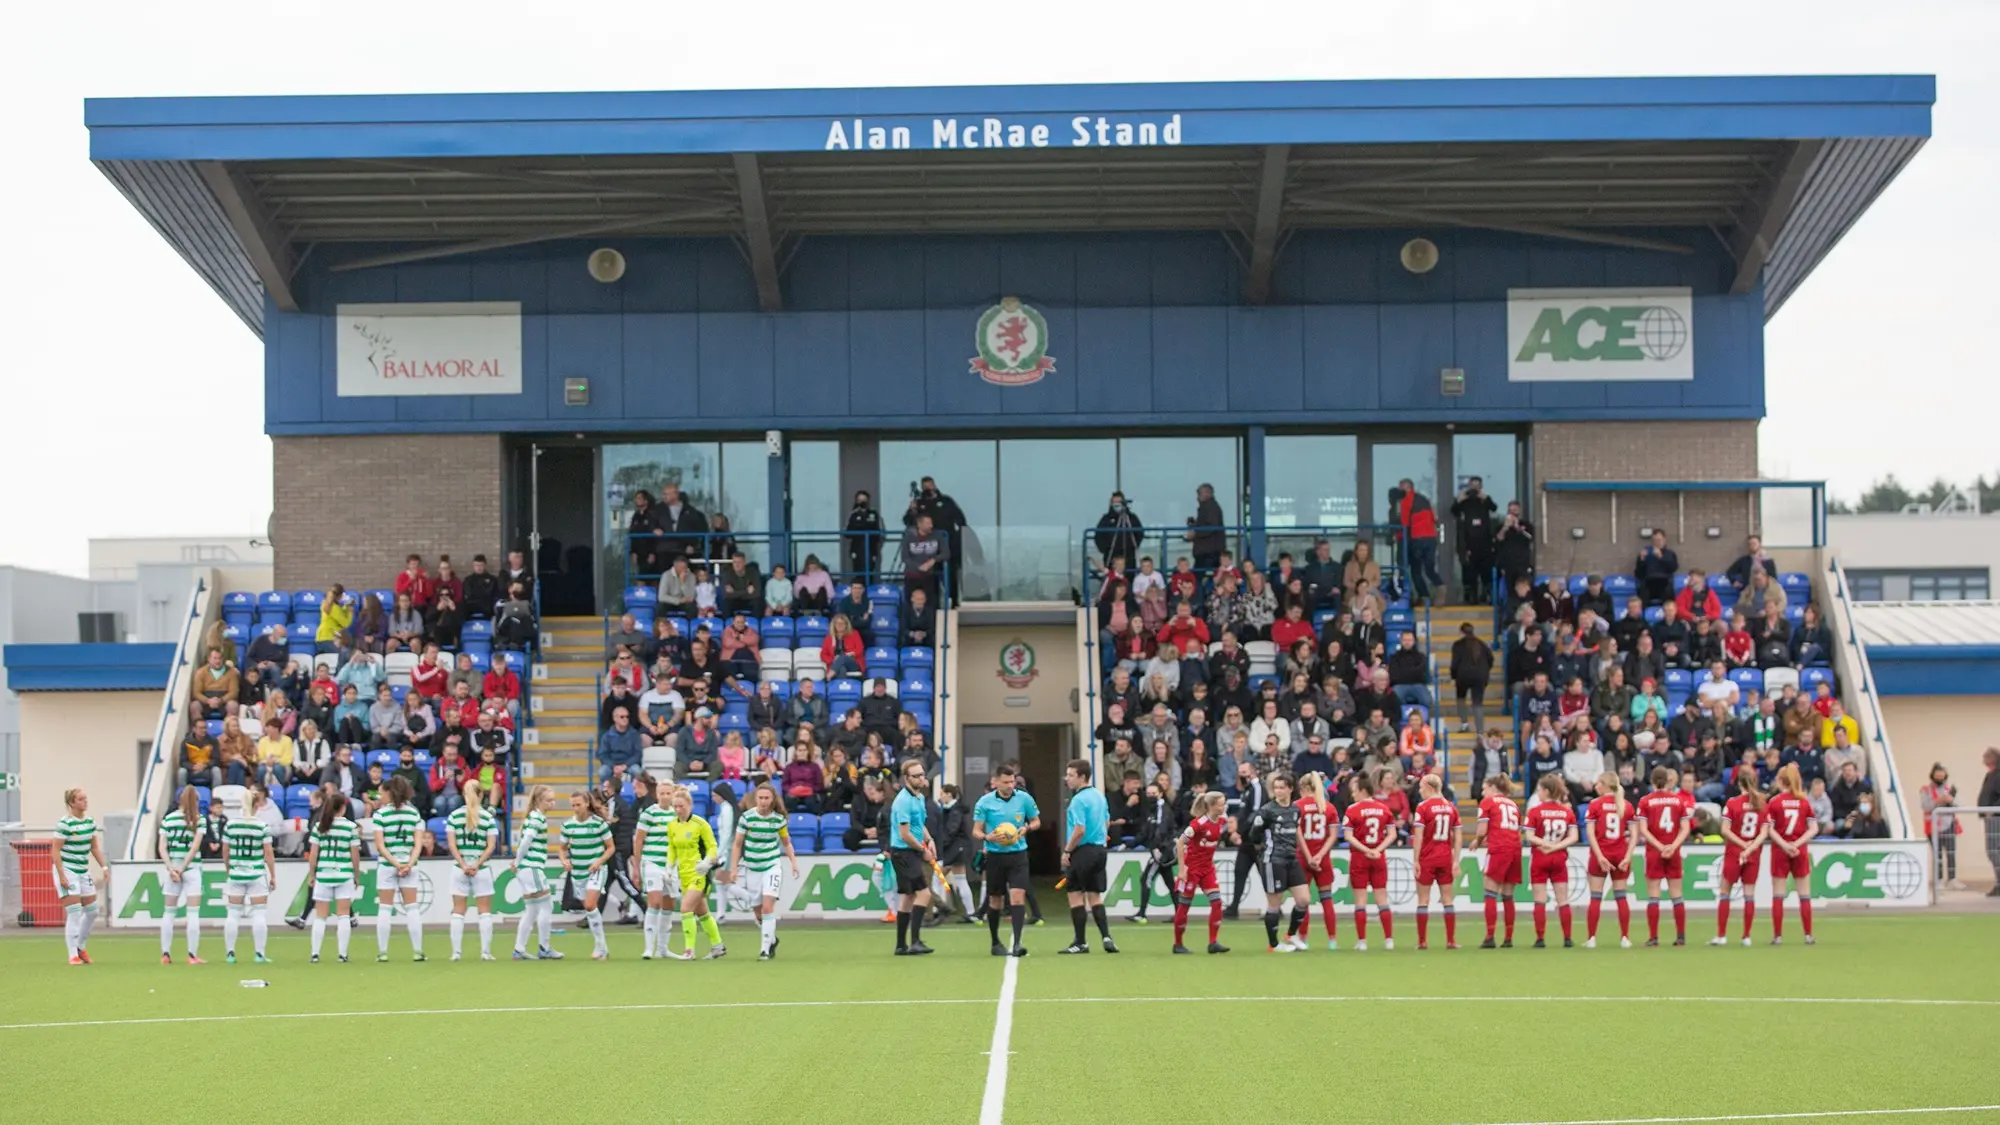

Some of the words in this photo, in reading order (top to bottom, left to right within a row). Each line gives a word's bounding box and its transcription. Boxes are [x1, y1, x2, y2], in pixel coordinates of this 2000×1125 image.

[825, 119, 911, 150] Alan
[933, 117, 1049, 149] McRae
[1072, 113, 1182, 146] Stand
[1515, 305, 1650, 362] ACE
[383, 359, 505, 379] BALMORAL
[1303, 813, 1327, 840] 13
[1365, 817, 1380, 844] 3
[1433, 814, 1450, 841] 11
[1499, 803, 1519, 831] 15
[1605, 812, 1620, 840] 9
[1659, 806, 1674, 833] 4
[1741, 812, 1759, 838] 8
[1784, 809, 1800, 835] 7
[769, 874, 780, 888] 15
